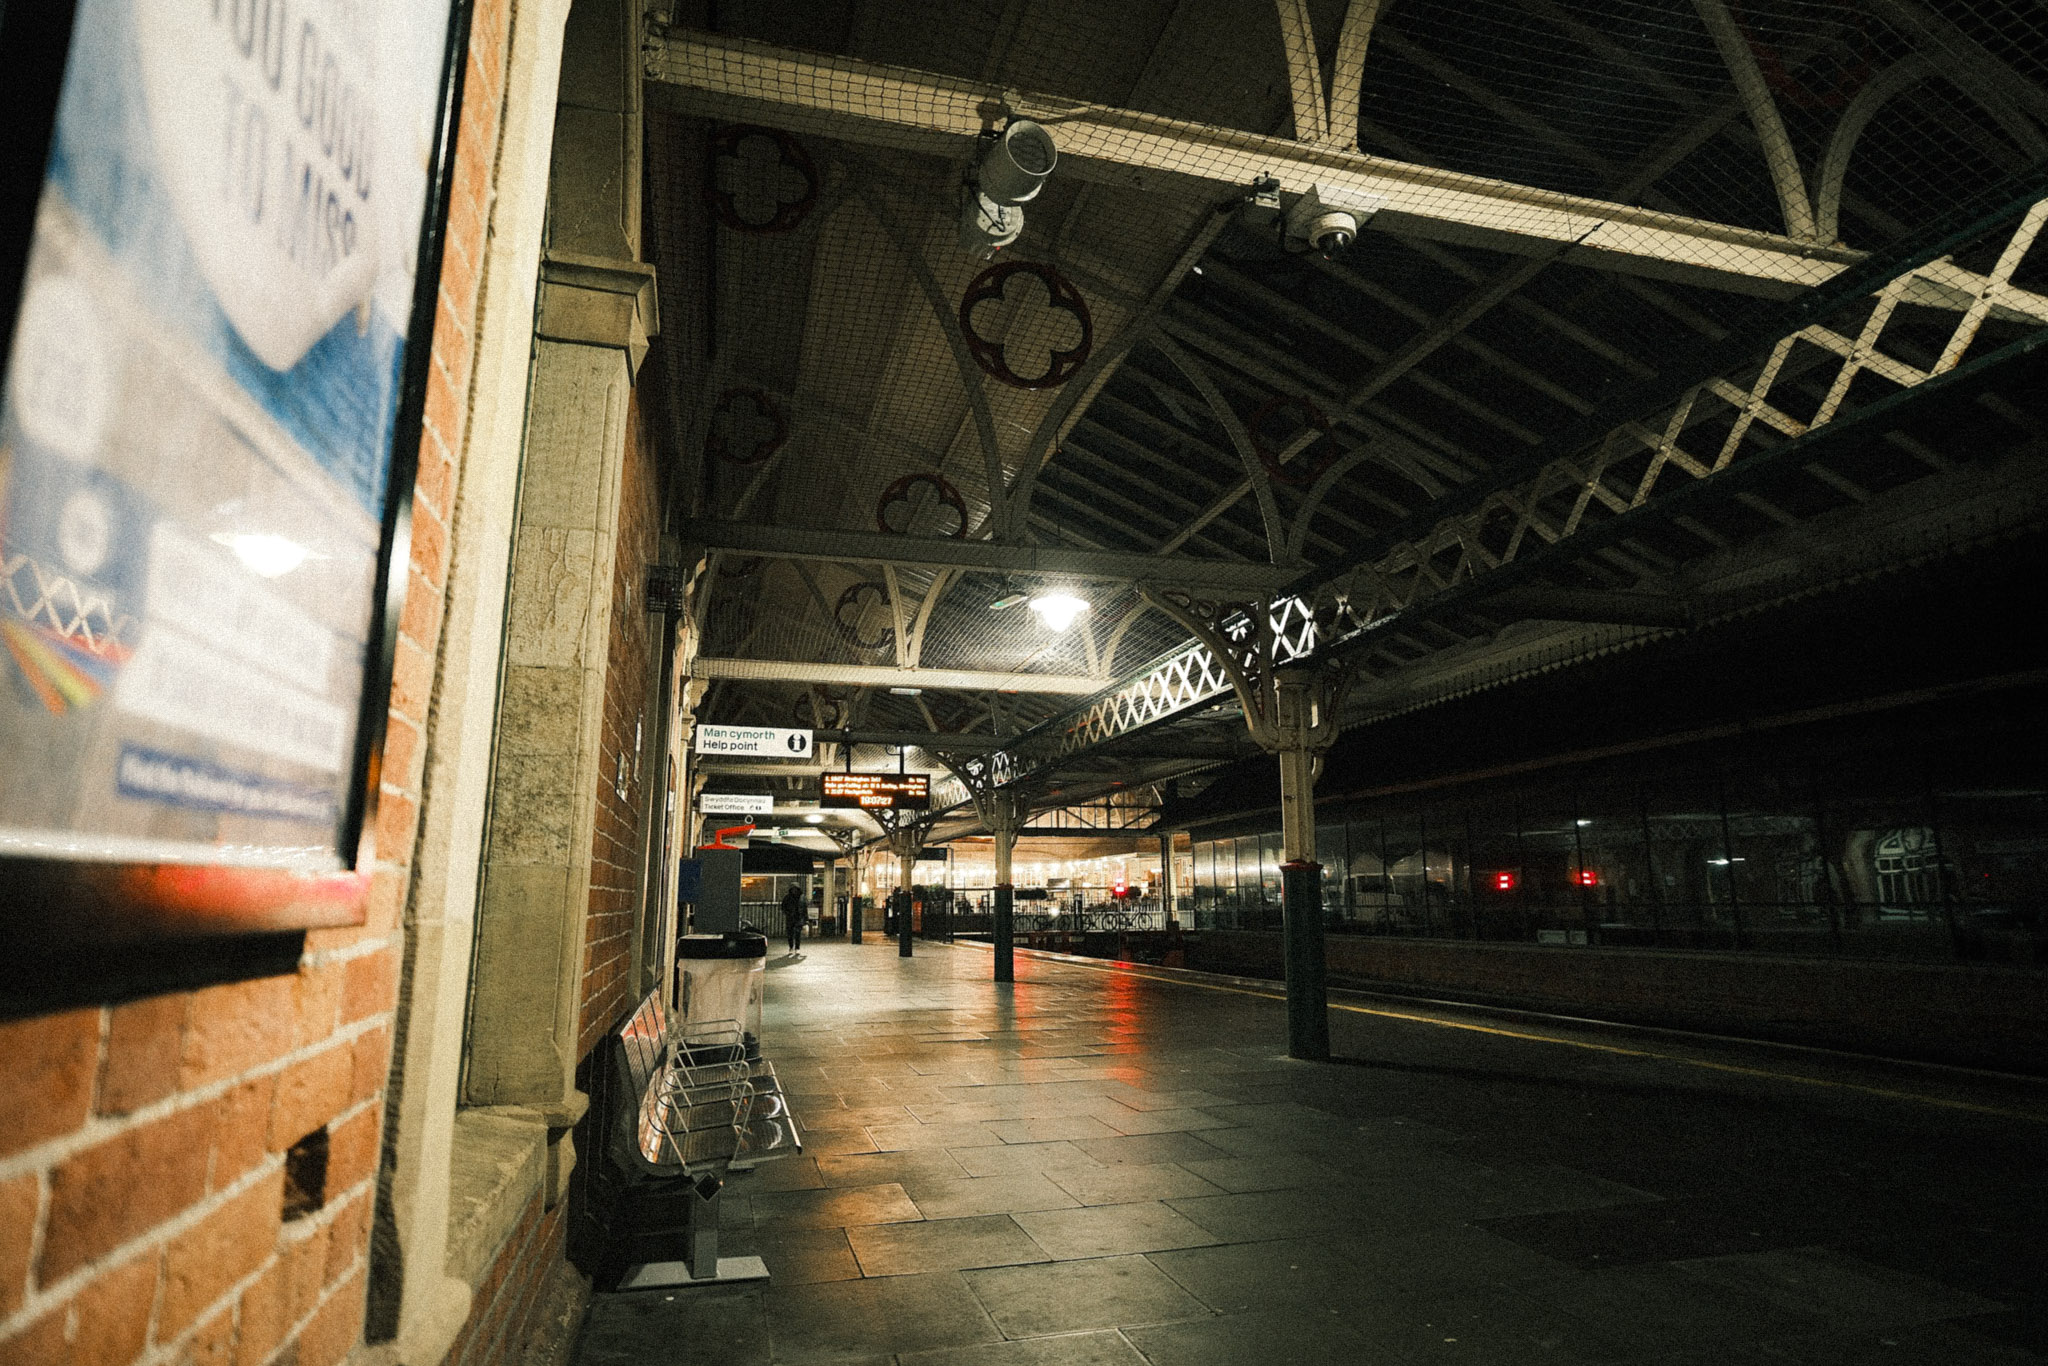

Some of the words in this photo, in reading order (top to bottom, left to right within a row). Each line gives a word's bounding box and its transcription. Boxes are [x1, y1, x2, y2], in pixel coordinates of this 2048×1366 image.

[704, 728, 727, 738] Man
[730, 730, 775, 740] cymorth
[703, 740, 728, 751] Help
[730, 742, 758, 751] point
